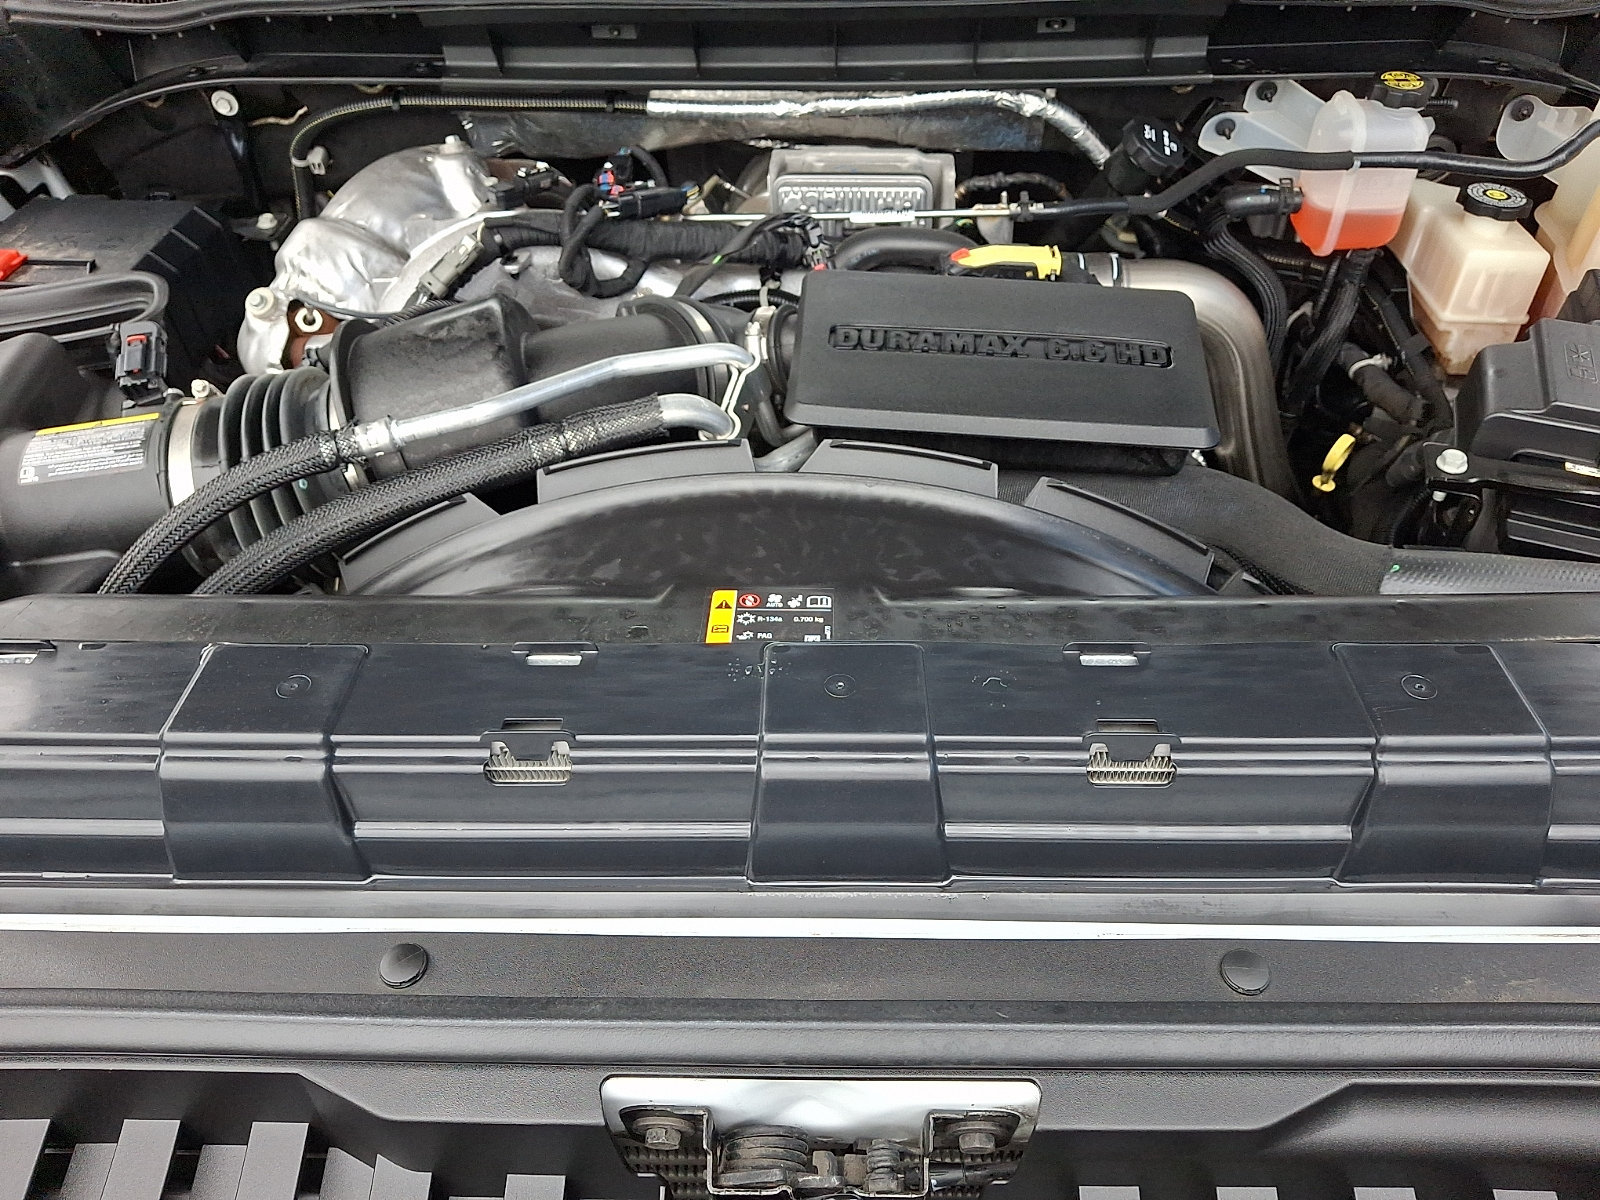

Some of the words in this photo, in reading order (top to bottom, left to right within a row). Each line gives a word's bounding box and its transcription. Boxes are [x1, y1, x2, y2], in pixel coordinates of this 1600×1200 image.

[834, 327, 1029, 358] DURAMAX
[1047, 338, 1107, 363] 6.6
[1115, 343, 1171, 369] HD
